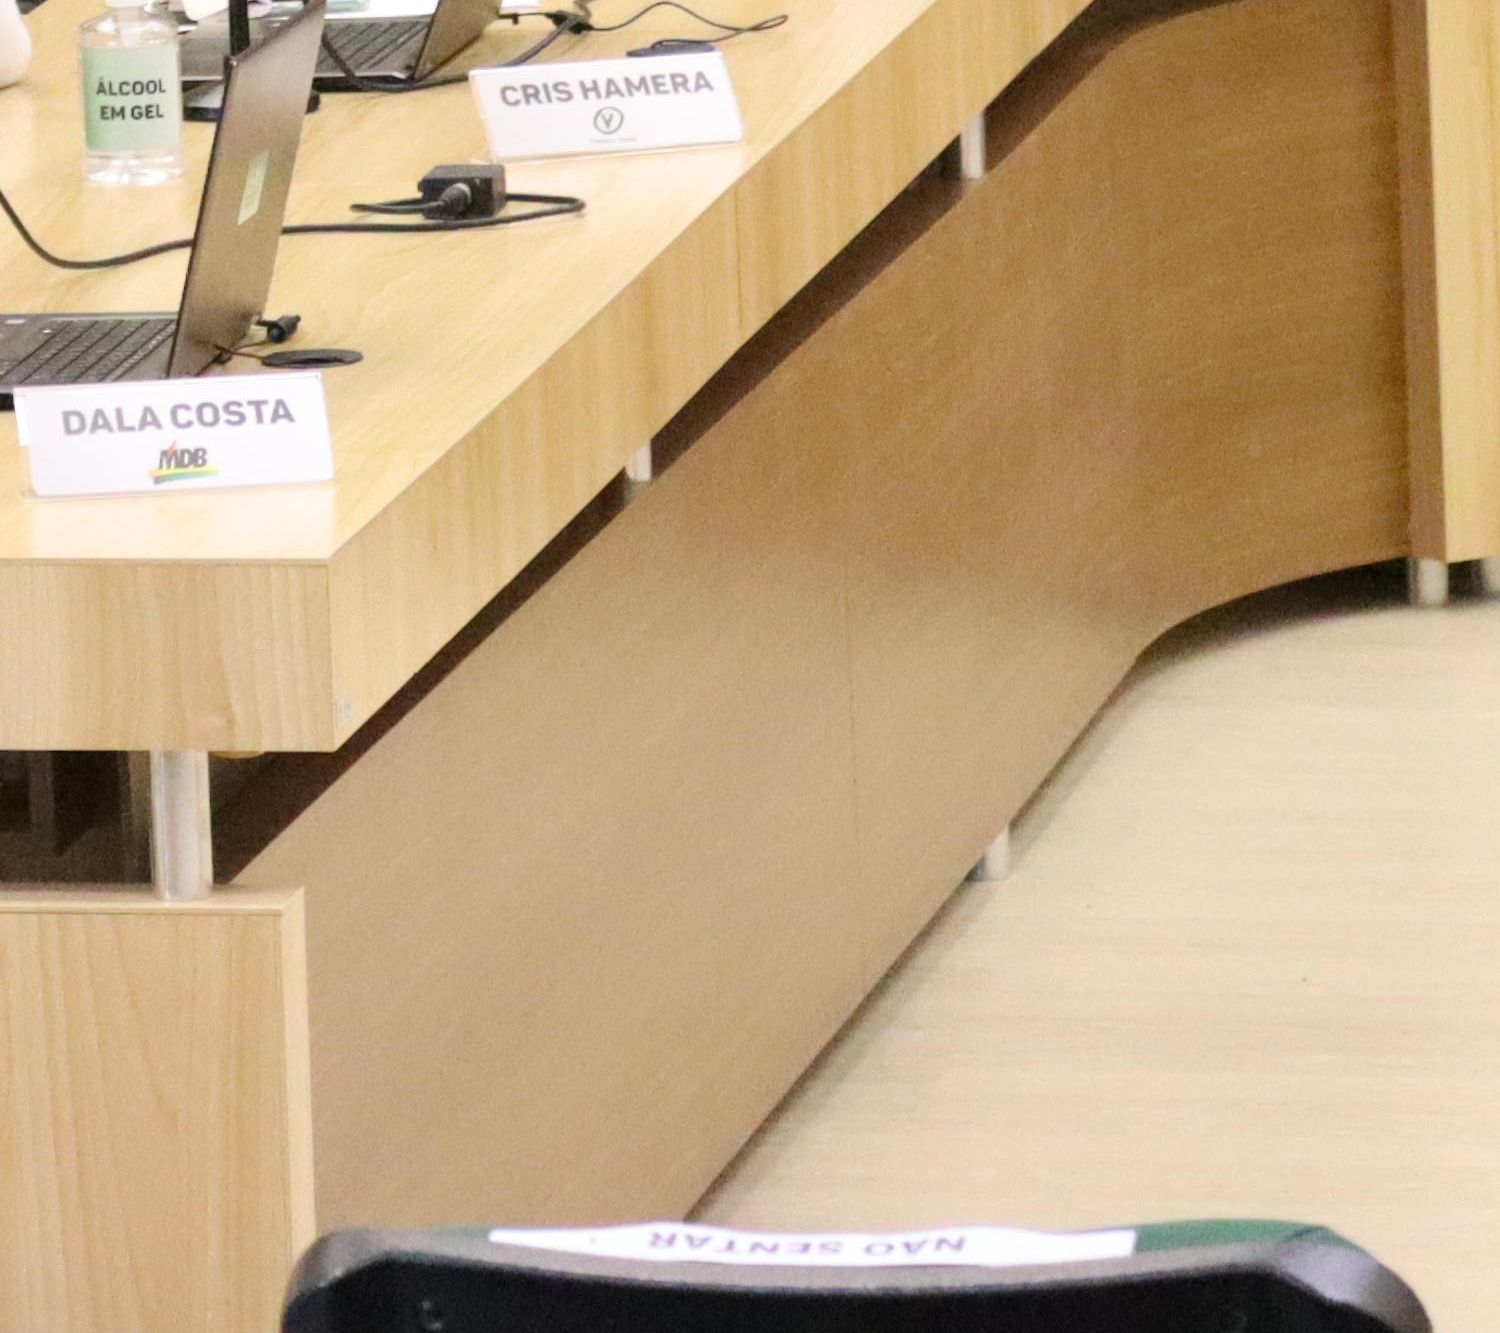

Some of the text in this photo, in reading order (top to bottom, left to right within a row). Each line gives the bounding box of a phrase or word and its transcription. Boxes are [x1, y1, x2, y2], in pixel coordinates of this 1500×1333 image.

[96, 76, 167, 97] ÁLCOOL
[499, 71, 715, 108] CRIS HAMERA
[100, 104, 164, 121] EM GEL
[61, 399, 296, 436] DALA COSTA
[158, 446, 208, 470] MDB
[648, 1232, 844, 1256] SENTAR
